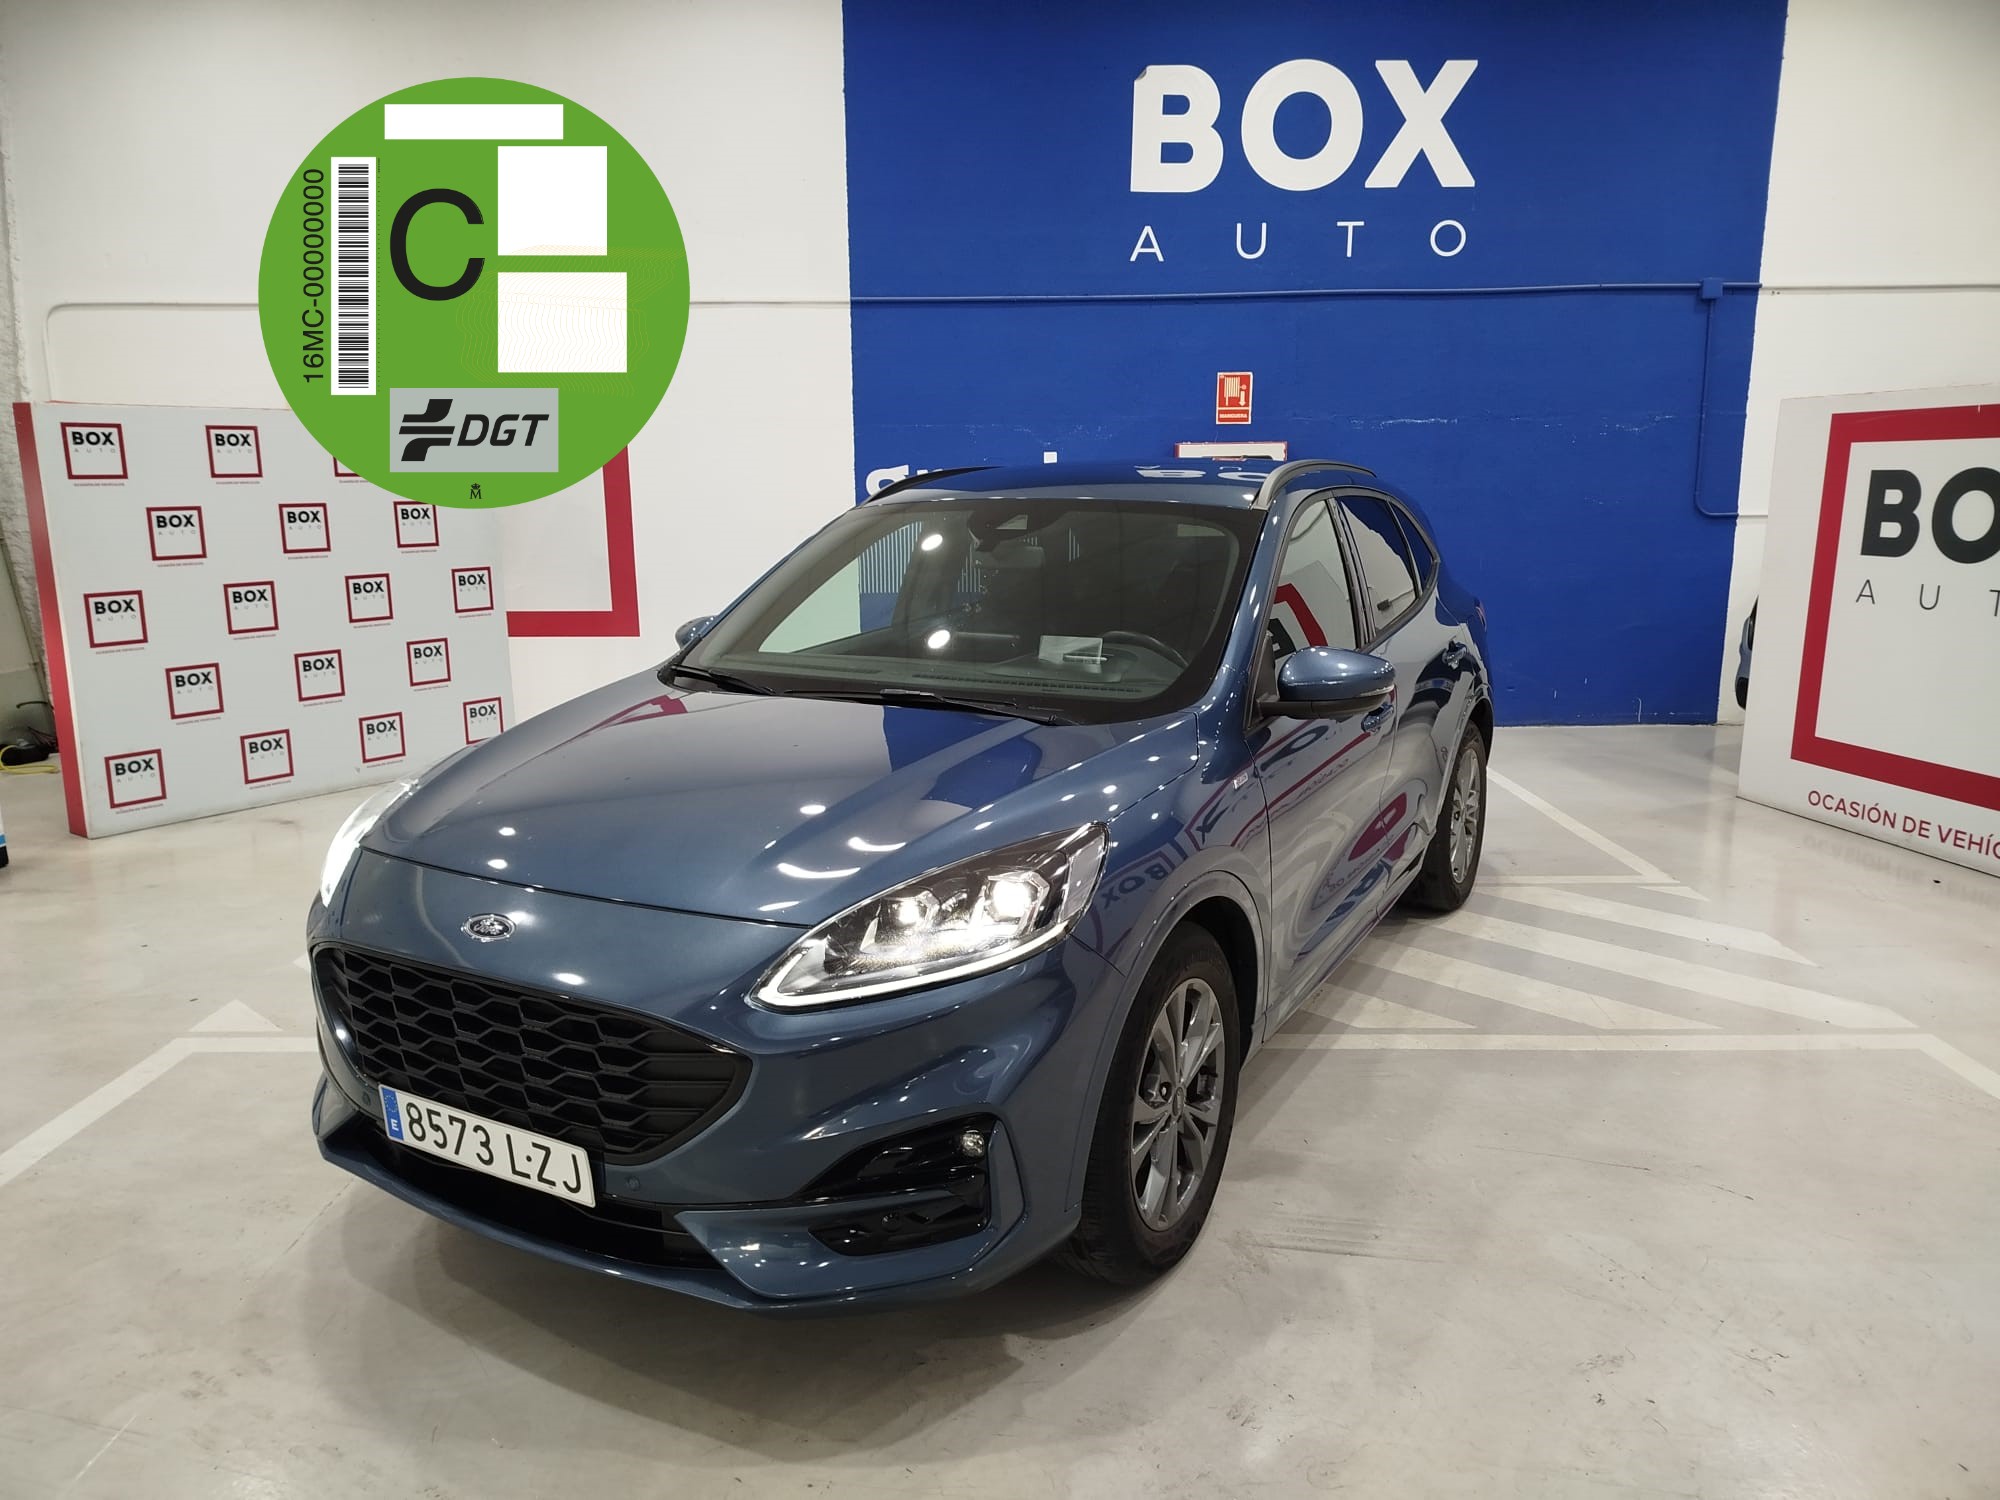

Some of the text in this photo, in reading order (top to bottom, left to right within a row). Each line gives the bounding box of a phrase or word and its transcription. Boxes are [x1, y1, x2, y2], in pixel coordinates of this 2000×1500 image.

[1130, 58, 1478, 193] BOX
[1130, 219, 1467, 262] AUTO
[72, 431, 114, 446] BOX
[215, 433, 252, 447] BOX
[155, 514, 195, 528] BOX
[287, 510, 321, 524] BOX
[400, 507, 431, 520] BOX
[352, 580, 384, 594] BOX
[458, 573, 486, 587] BOX
[232, 588, 268, 603] BOX
[94, 598, 136, 615] BOX
[413, 645, 443, 659] BOX
[302, 657, 336, 672] BOX
[174, 671, 213, 688] BOX
[469, 704, 497, 718] BOX
[366, 719, 397, 735] BOX
[248, 737, 284, 754] BOX
[115, 757, 155, 776] BOX
[1807, 790, 1897, 829] OCASIÓN
[1902, 815, 1931, 839] DE
[405, 1102, 495, 1166] 8573
